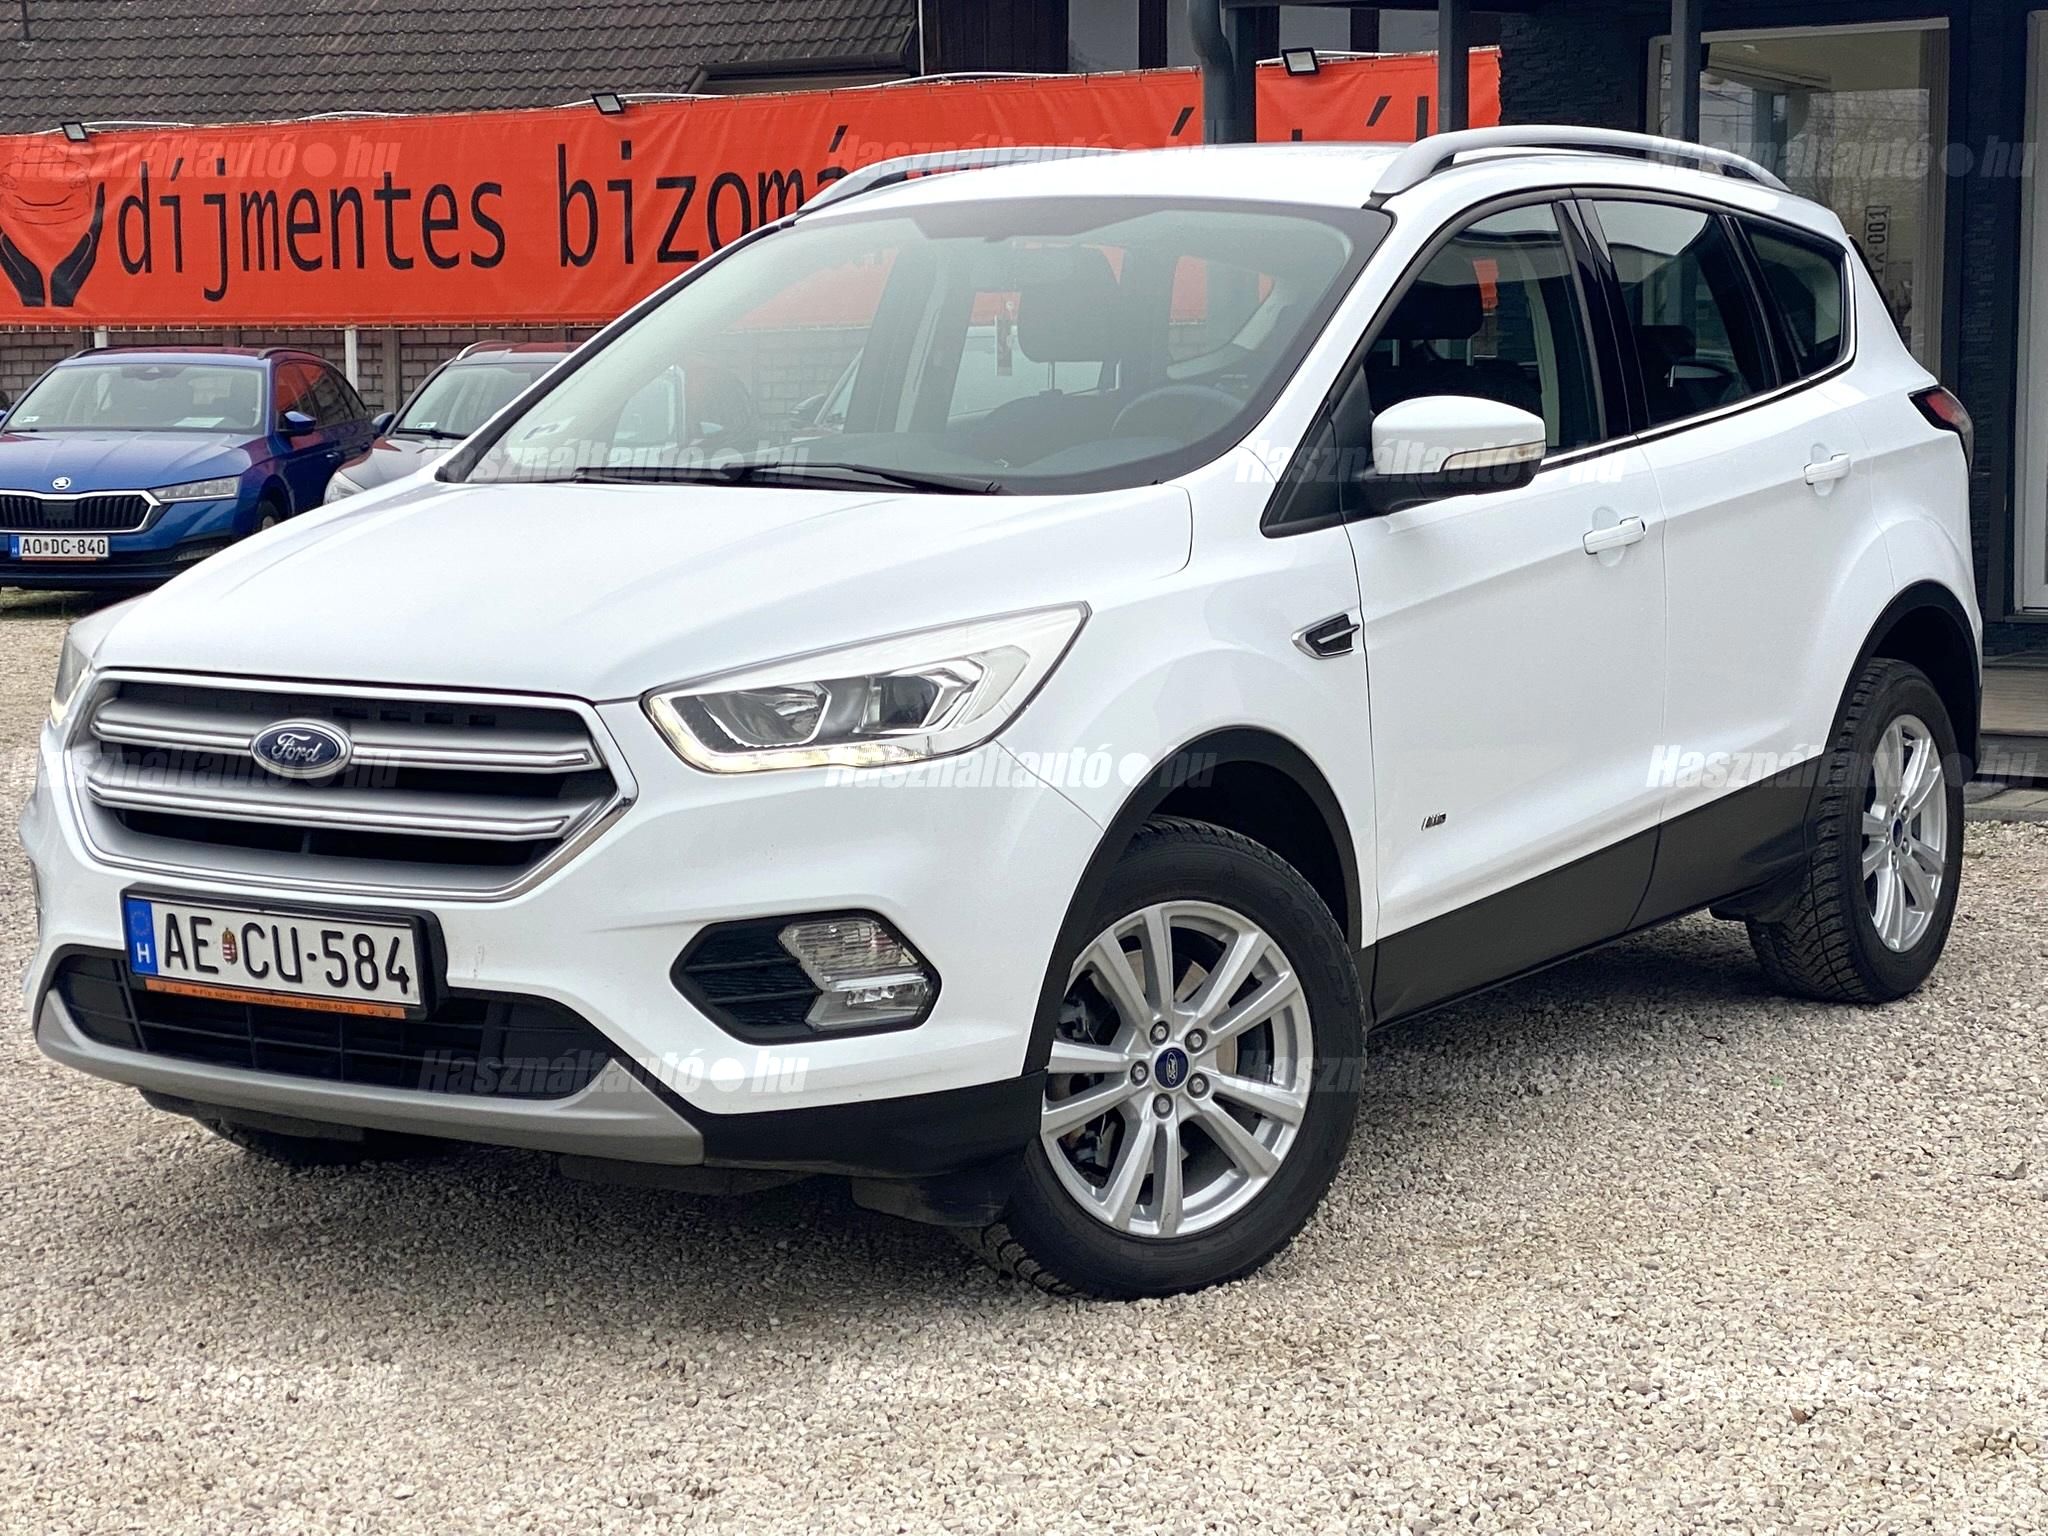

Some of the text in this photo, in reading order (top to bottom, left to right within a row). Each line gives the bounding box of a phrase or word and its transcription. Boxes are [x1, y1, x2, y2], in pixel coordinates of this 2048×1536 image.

[117, 157, 505, 301] díjmentes
[271, 732, 323, 762] Ford
[137, 942, 151, 965] H
